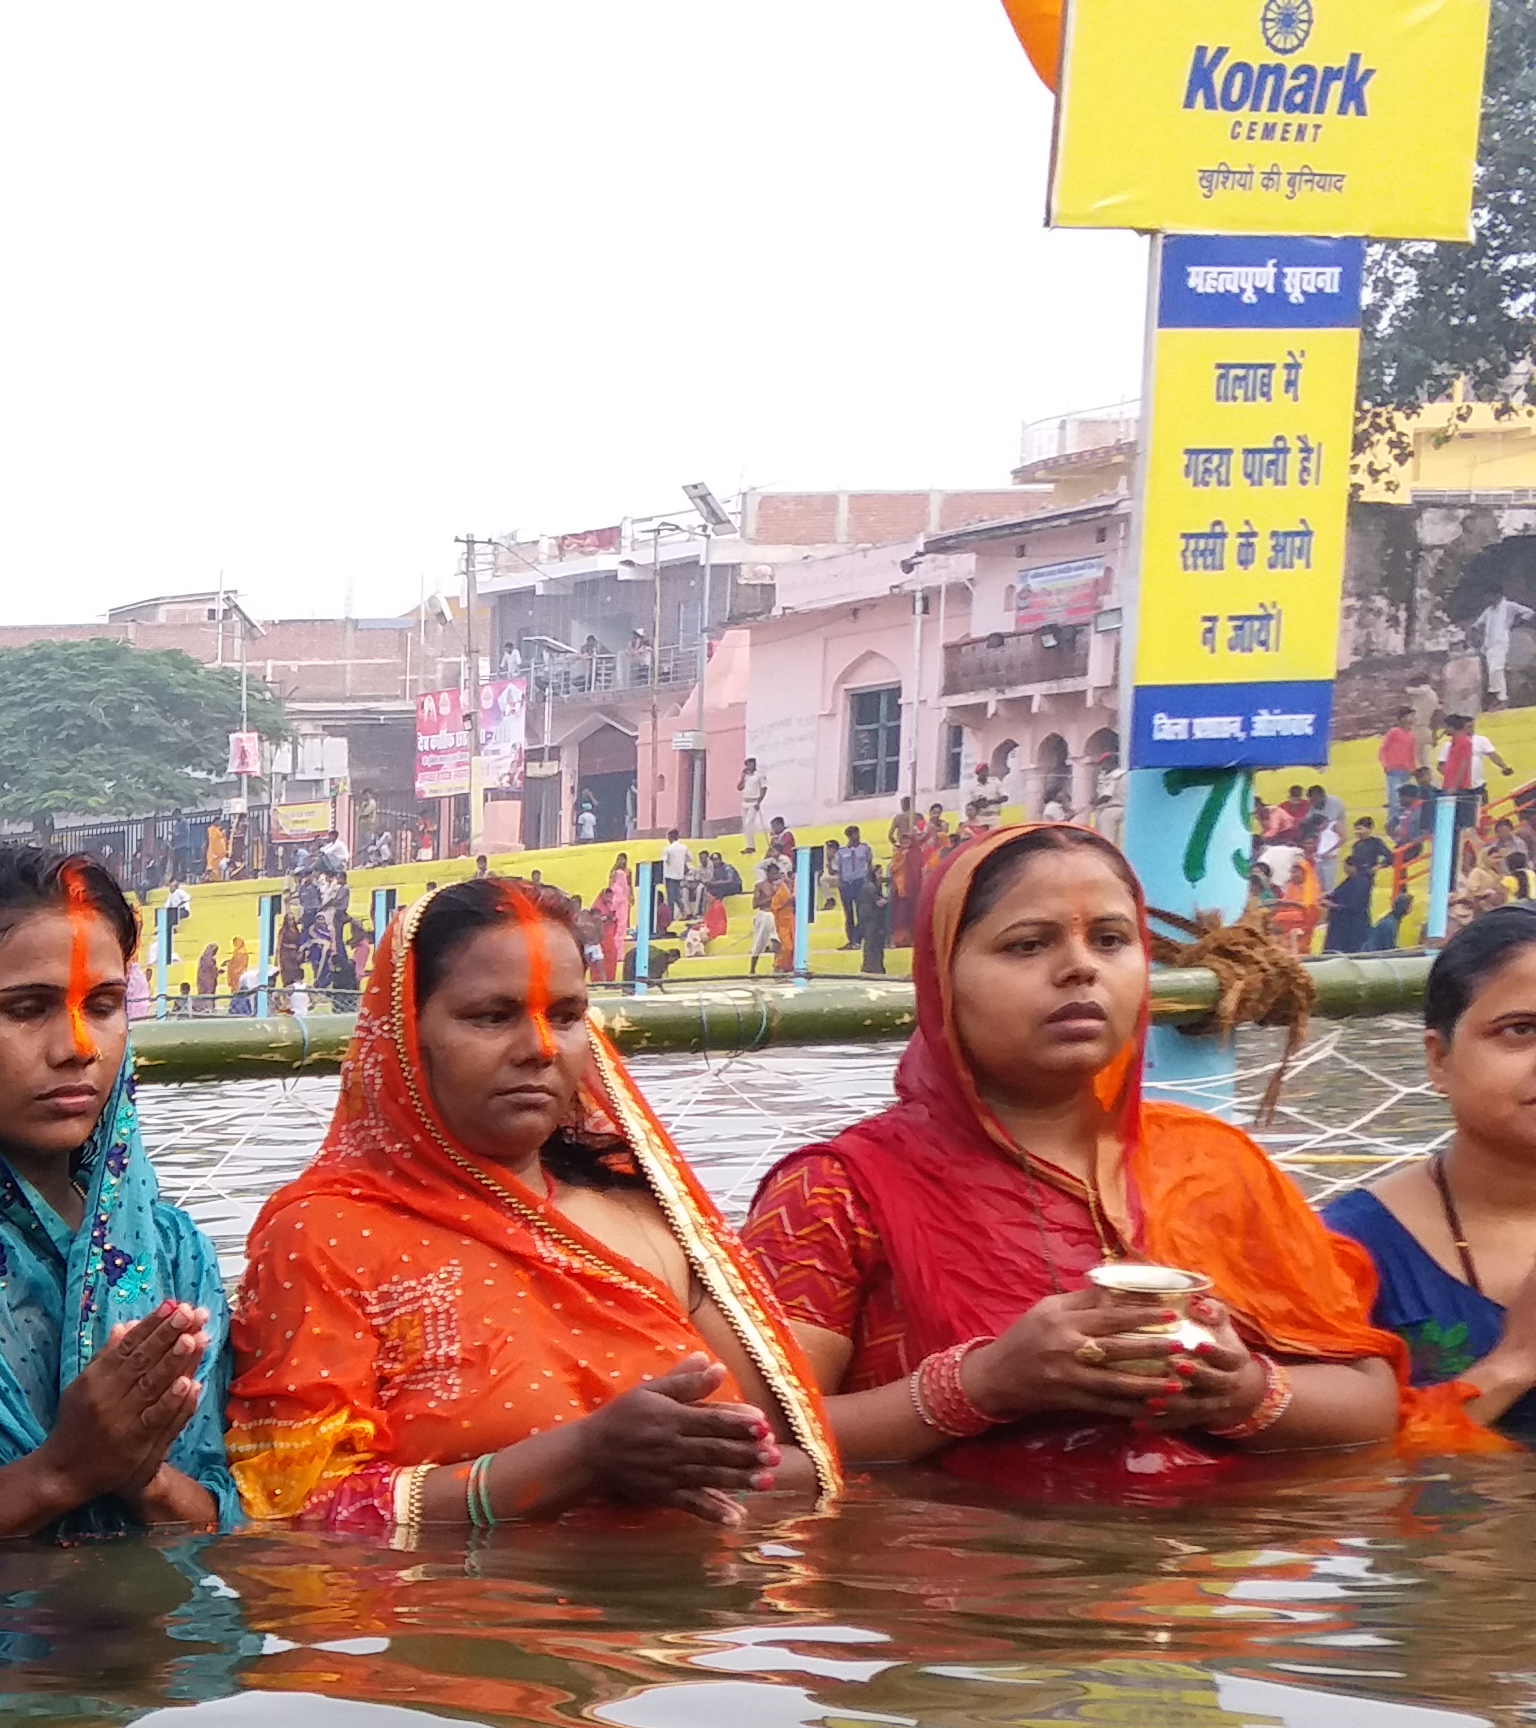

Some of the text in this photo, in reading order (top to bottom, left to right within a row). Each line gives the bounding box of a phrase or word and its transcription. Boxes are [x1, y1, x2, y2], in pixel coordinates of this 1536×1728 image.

[1183, 45, 1376, 117] Konark
[1230, 121, 1323, 143] CEMENT
[1197, 162, 1347, 200] खुशियों की बुनियाद
[1187, 259, 1343, 304] महत्वपूर्ण सूचना
[1215, 350, 1305, 402] तलाब में
[1184, 448, 1234, 487] गहरा
[1242, 435, 1292, 487] पानी
[1236, 519, 1258, 570] के
[1267, 519, 1313, 569] आगे
[1201, 615, 1219, 654] न
